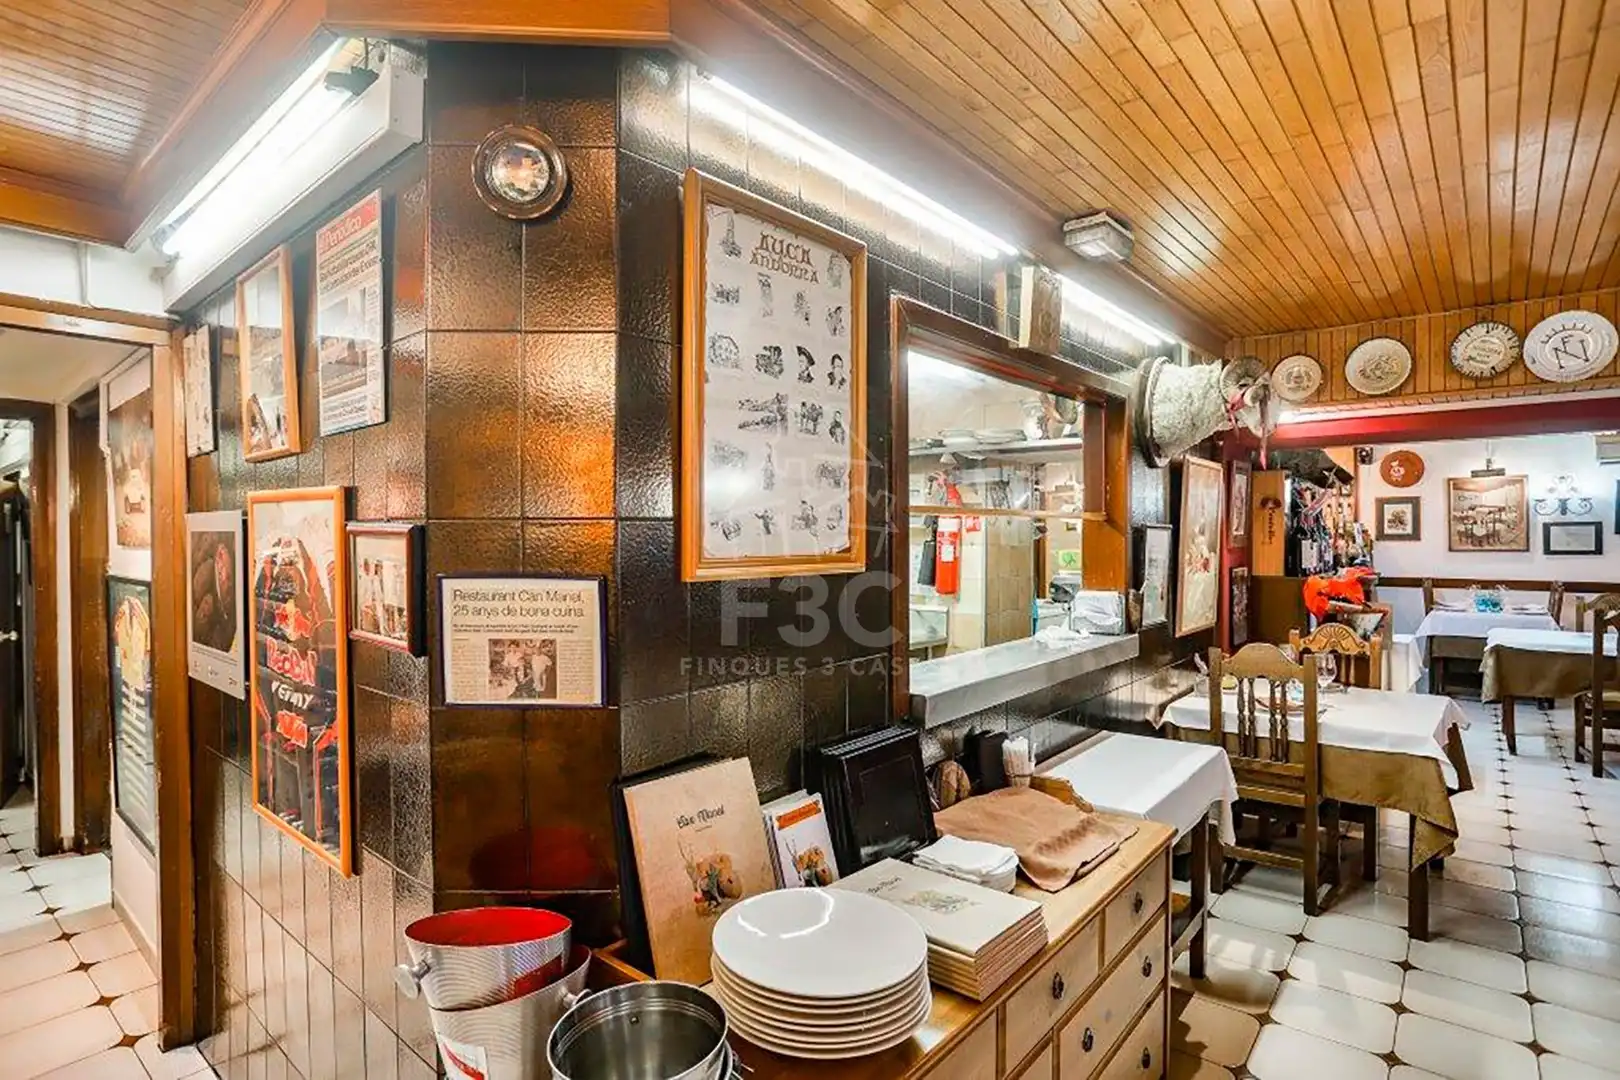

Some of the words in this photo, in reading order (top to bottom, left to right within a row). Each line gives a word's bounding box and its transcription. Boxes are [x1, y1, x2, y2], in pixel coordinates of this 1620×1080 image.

[453, 588, 516, 601] Restaurant
[518, 588, 543, 601] Can
[453, 604, 470, 617] 25
[471, 605, 499, 619] anys
[500, 604, 518, 617] de
[519, 604, 550, 617] bona
